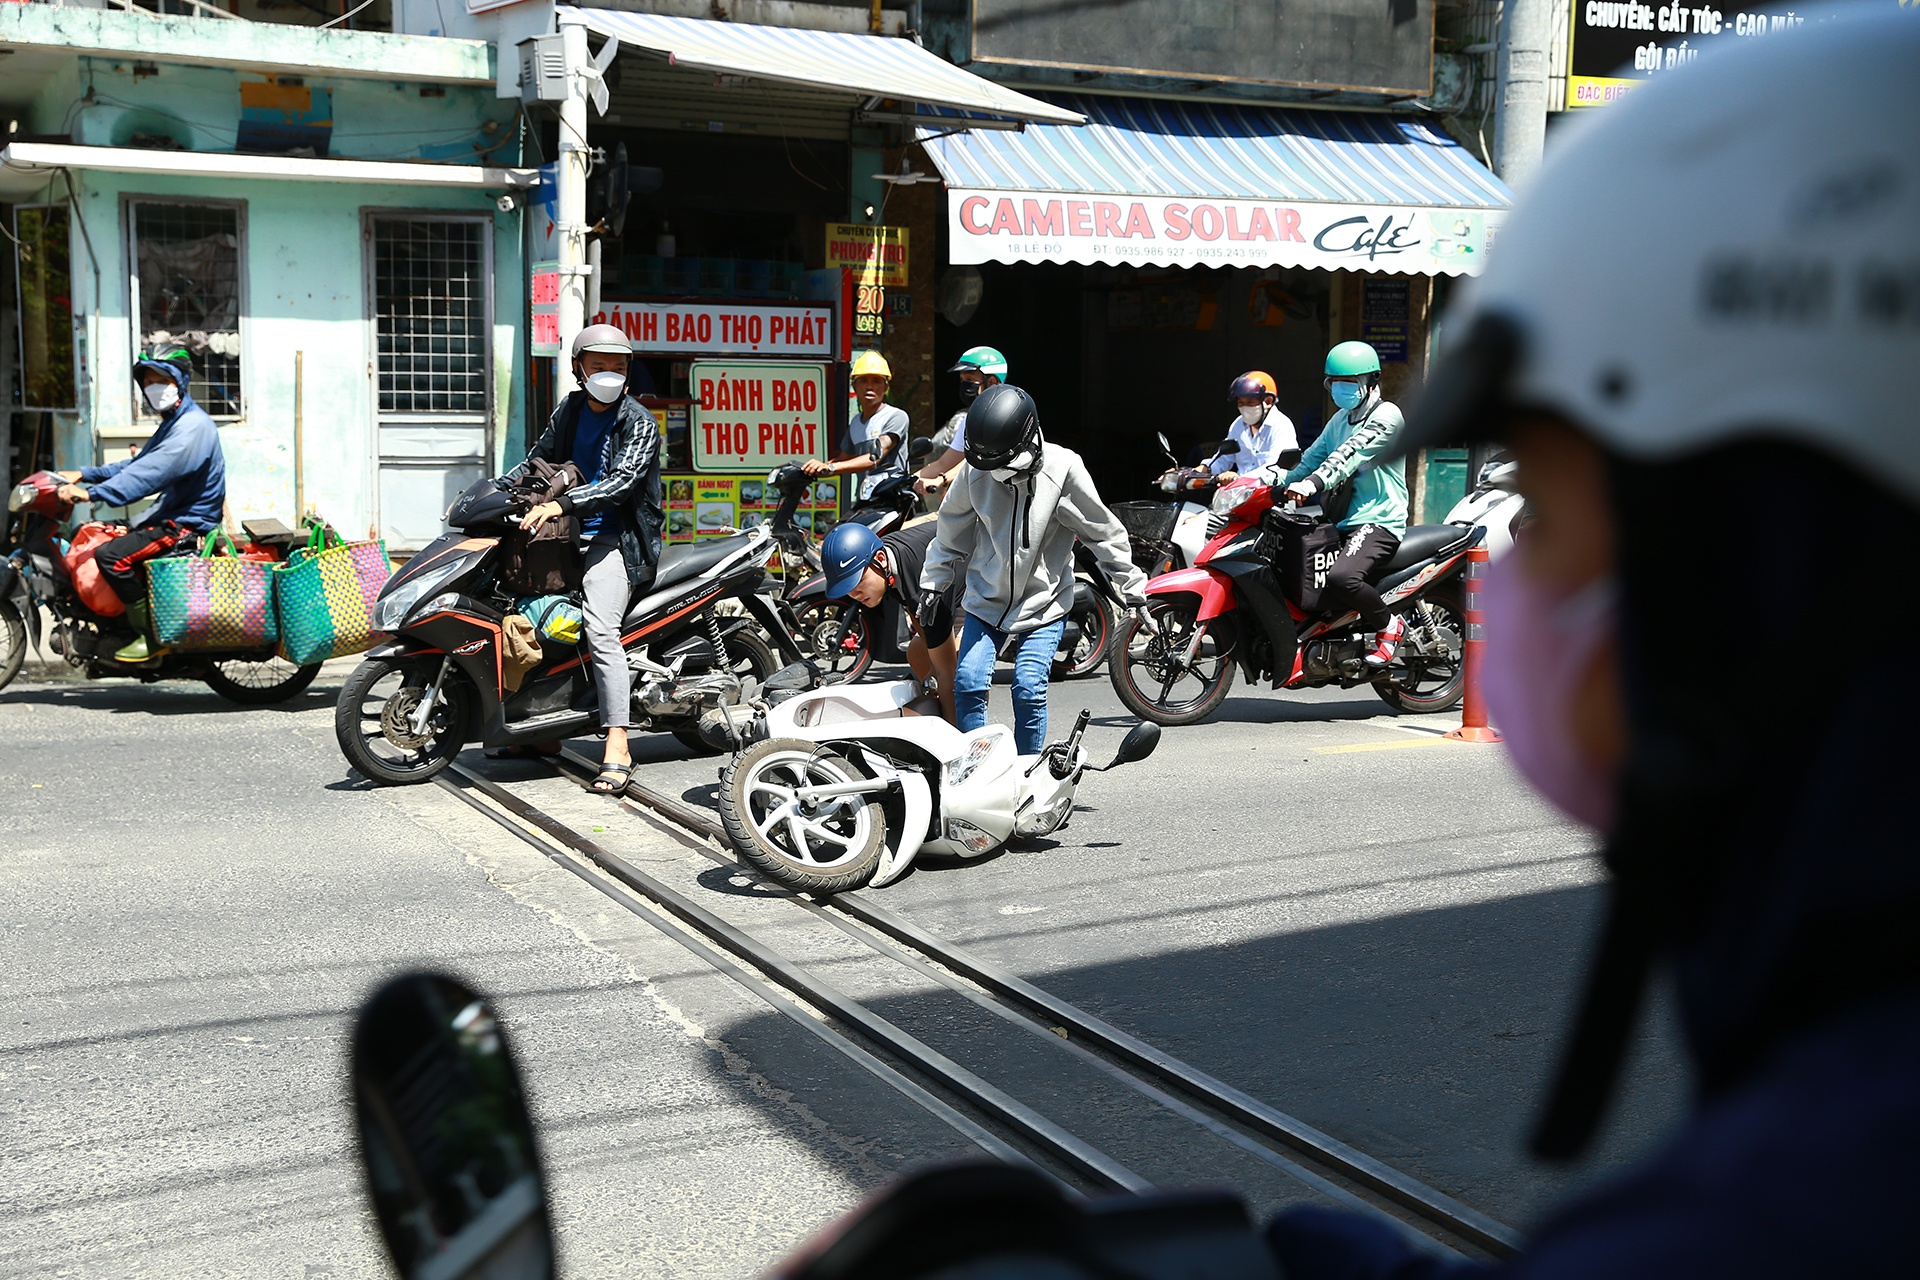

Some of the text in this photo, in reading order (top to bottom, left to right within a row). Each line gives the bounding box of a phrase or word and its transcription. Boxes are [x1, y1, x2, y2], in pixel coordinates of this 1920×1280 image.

[1692, 4, 1723, 35] TÓC
[1634, 41, 1663, 75] GỘI
[959, 195, 1156, 240] CAMERA
[1163, 203, 1307, 243] SOLAR
[830, 238, 877, 261] PHÒNG
[1008, 243, 1021, 254] 18
[1115, 246, 1164, 257] 0935.986
[1167, 247, 1185, 258] 927
[857, 286, 884, 314] 20
[893, 297, 907, 312] 18
[666, 313, 712, 343] BAO
[719, 314, 762, 350] THỌ
[770, 310, 827, 345] PHÁT
[700, 372, 817, 412] BÁNH BAO
[702, 416, 817, 462] THỌ PHÁT
[1314, 571, 1330, 589] M
